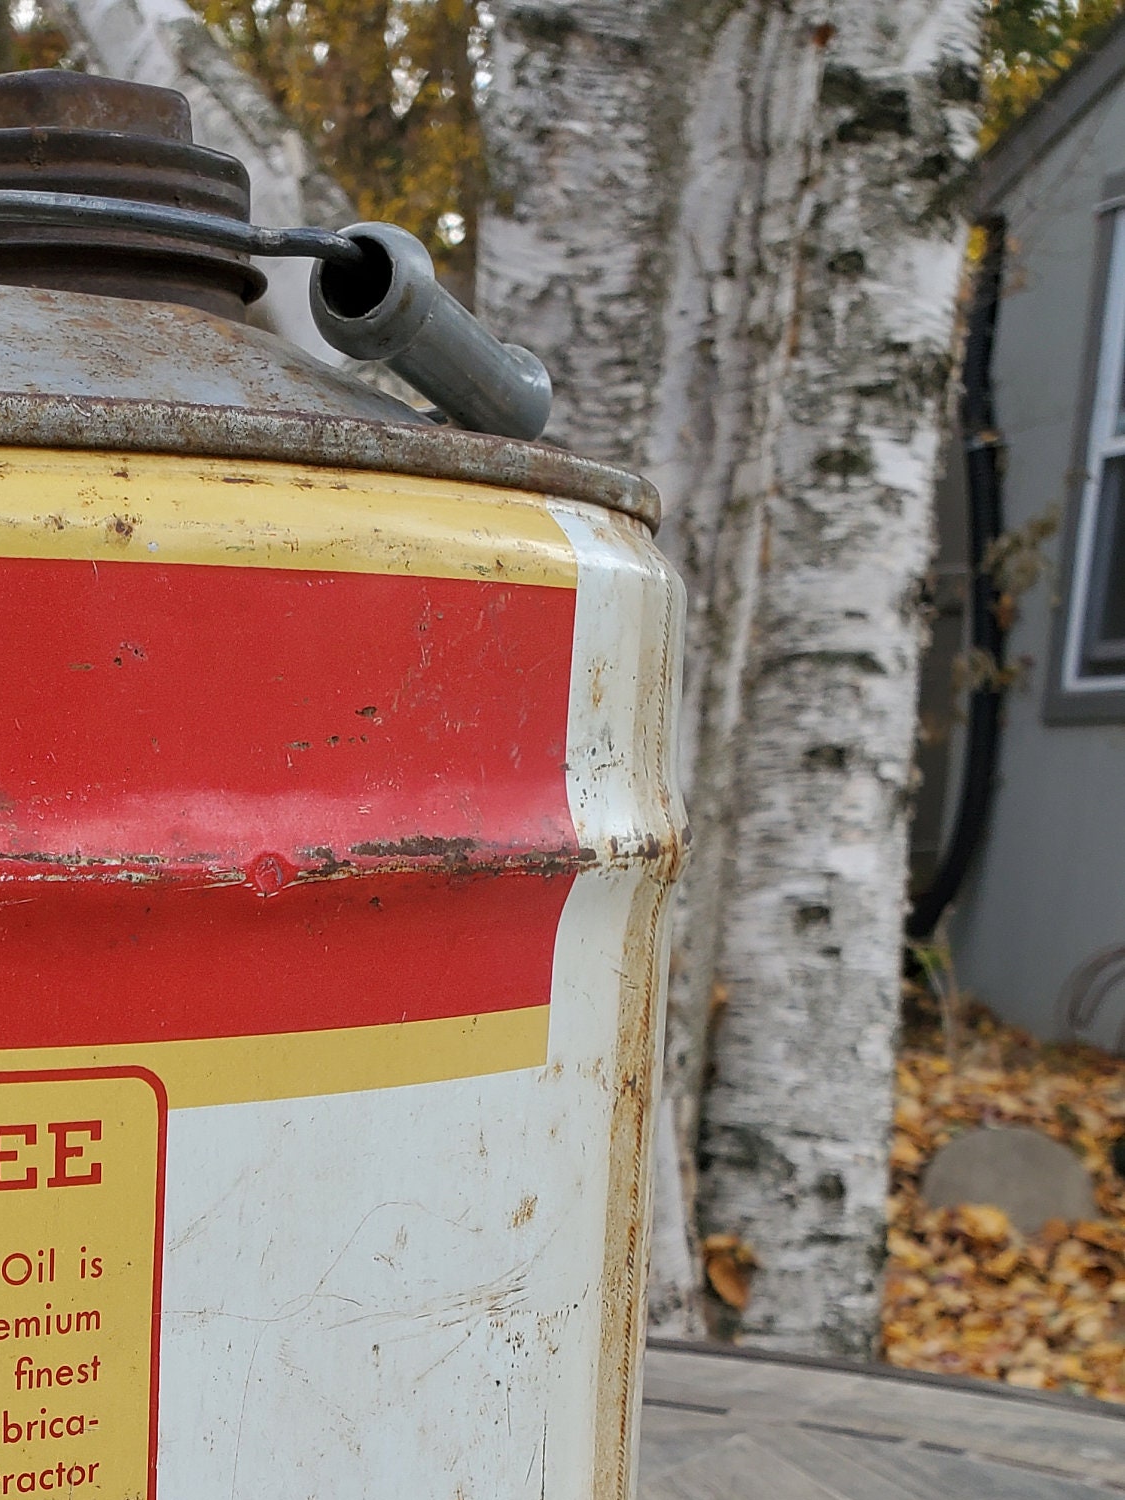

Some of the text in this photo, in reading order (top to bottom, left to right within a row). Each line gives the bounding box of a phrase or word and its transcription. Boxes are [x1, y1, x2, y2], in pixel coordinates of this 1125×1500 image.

[1, 1247, 55, 1286] Oil
[80, 1246, 103, 1279] is
[14, 1355, 101, 1391] finest
